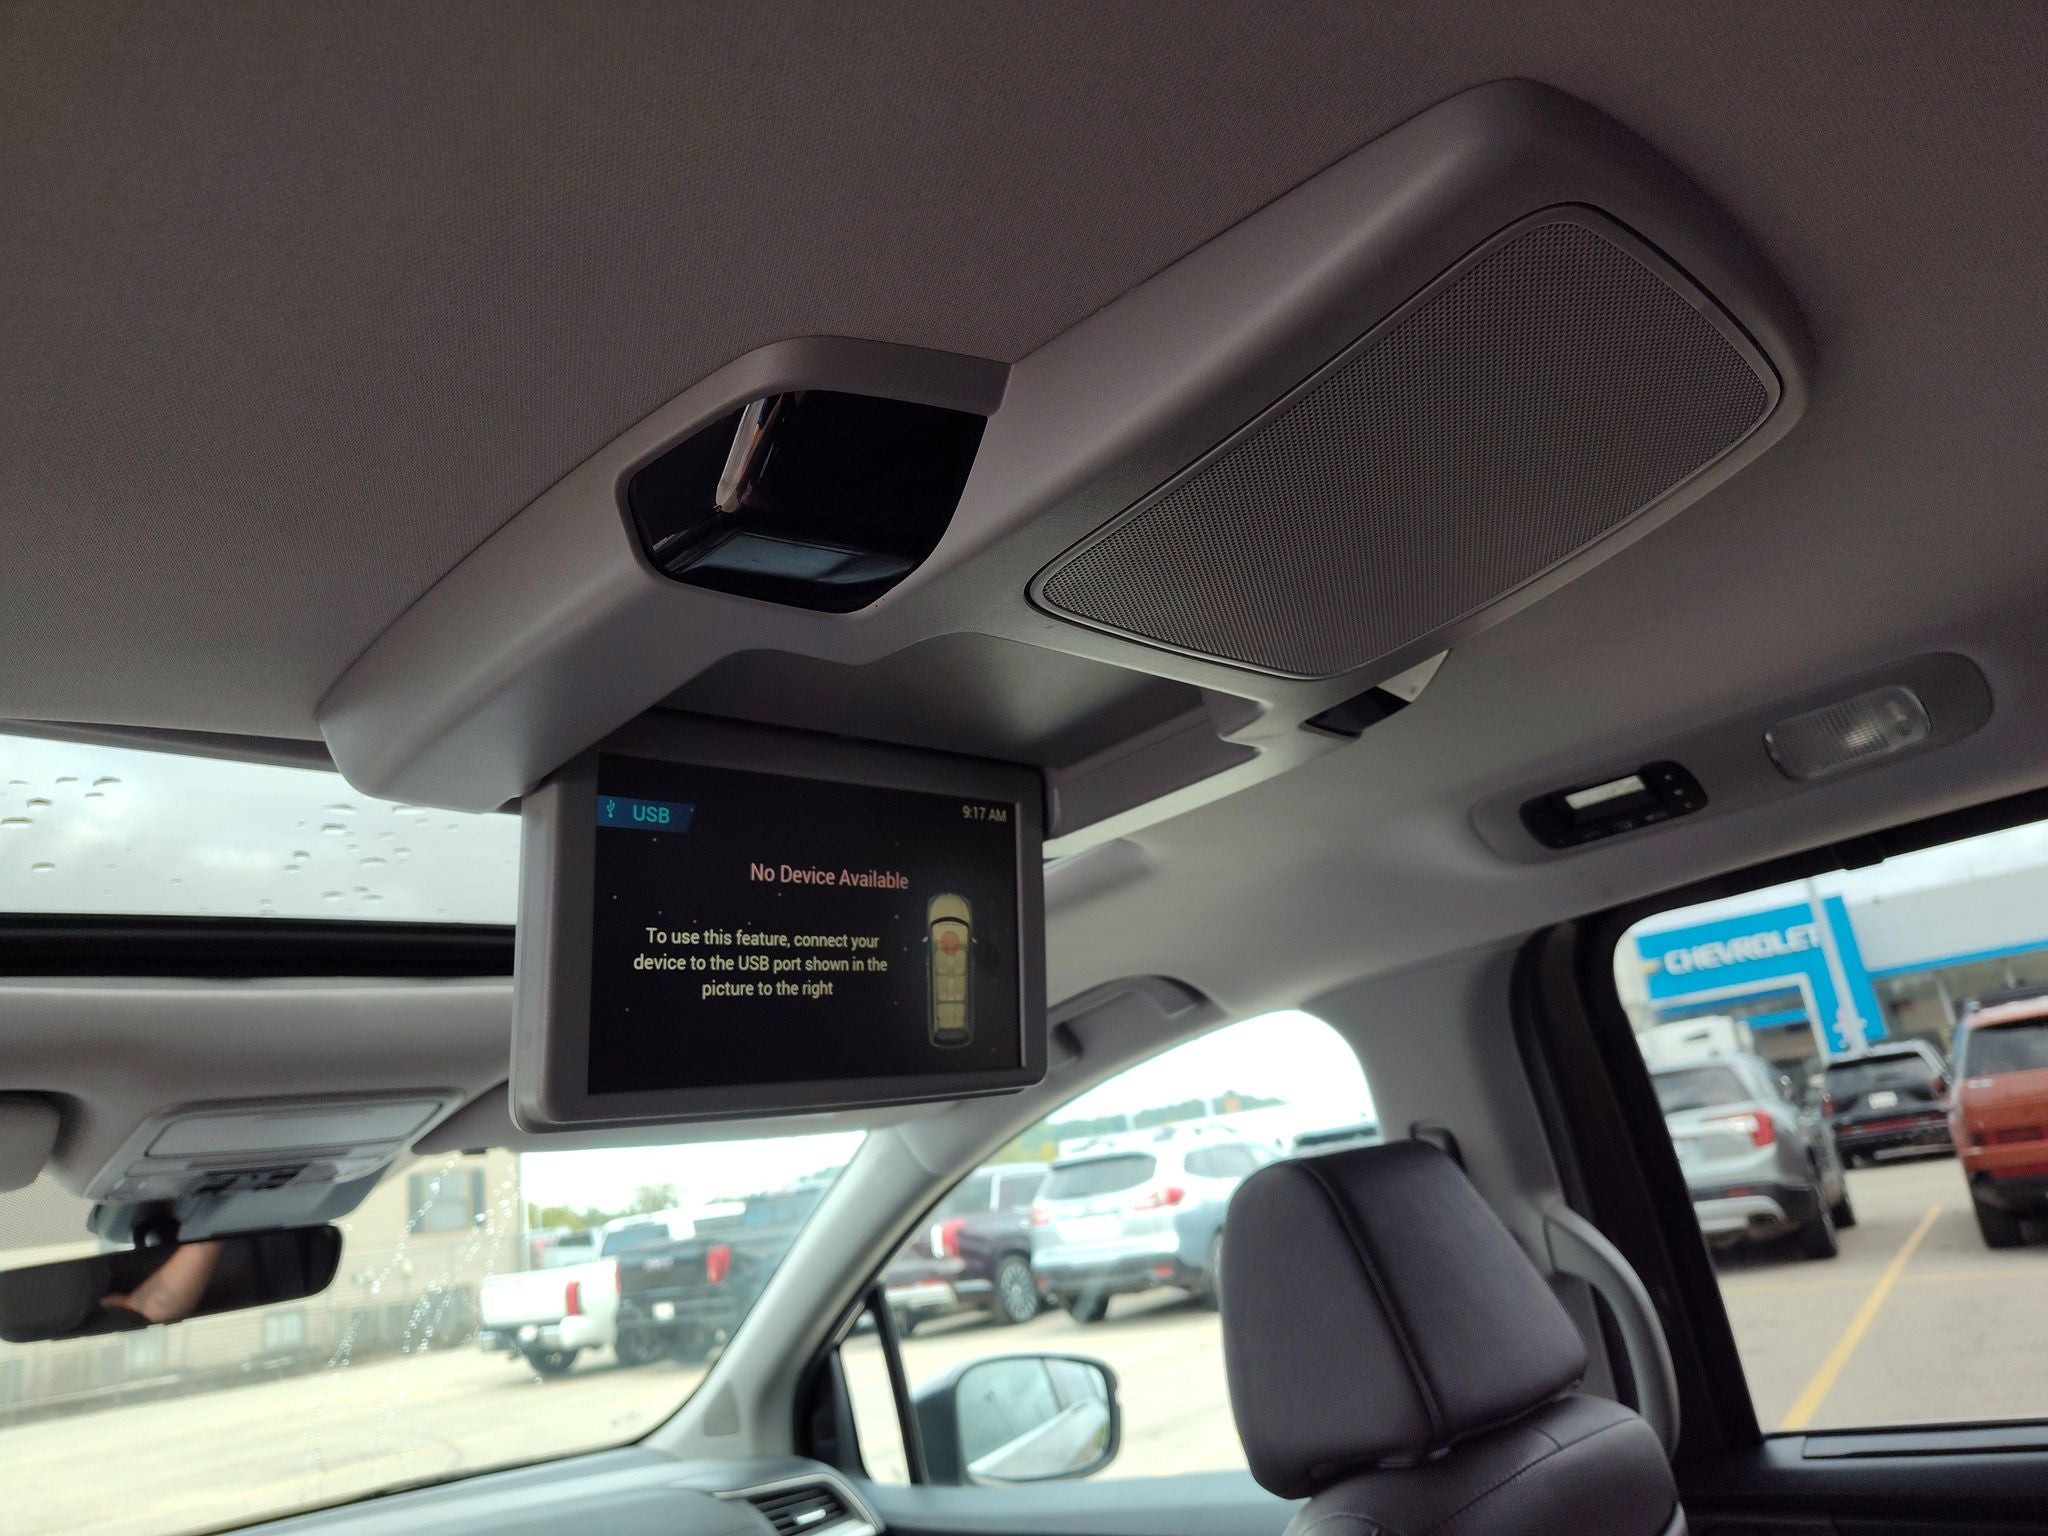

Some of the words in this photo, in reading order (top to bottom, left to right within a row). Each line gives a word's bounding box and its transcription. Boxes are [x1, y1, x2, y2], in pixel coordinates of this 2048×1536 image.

[632, 804, 670, 825] USB
[962, 804, 986, 821] 9:17
[988, 807, 1007, 822] AM
[750, 862, 776, 882] No
[780, 864, 835, 886] Device
[838, 868, 909, 890] Available
[645, 927, 668, 945] To
[671, 931, 701, 945] use
[703, 928, 733, 946] this
[735, 928, 791, 949] feature,
[793, 934, 848, 948] connect
[850, 936, 880, 952] your
[1664, 923, 1821, 975] CHEVROLET
[633, 952, 687, 971] device
[689, 955, 707, 971] to
[709, 953, 735, 971] the
[738, 954, 771, 971] USB
[773, 957, 802, 975] port
[804, 955, 850, 972] shown
[852, 955, 866, 972] in
[867, 956, 888, 972] the
[701, 979, 755, 1000] picture
[757, 981, 773, 996] to
[775, 979, 799, 996] the
[801, 979, 834, 999] right
